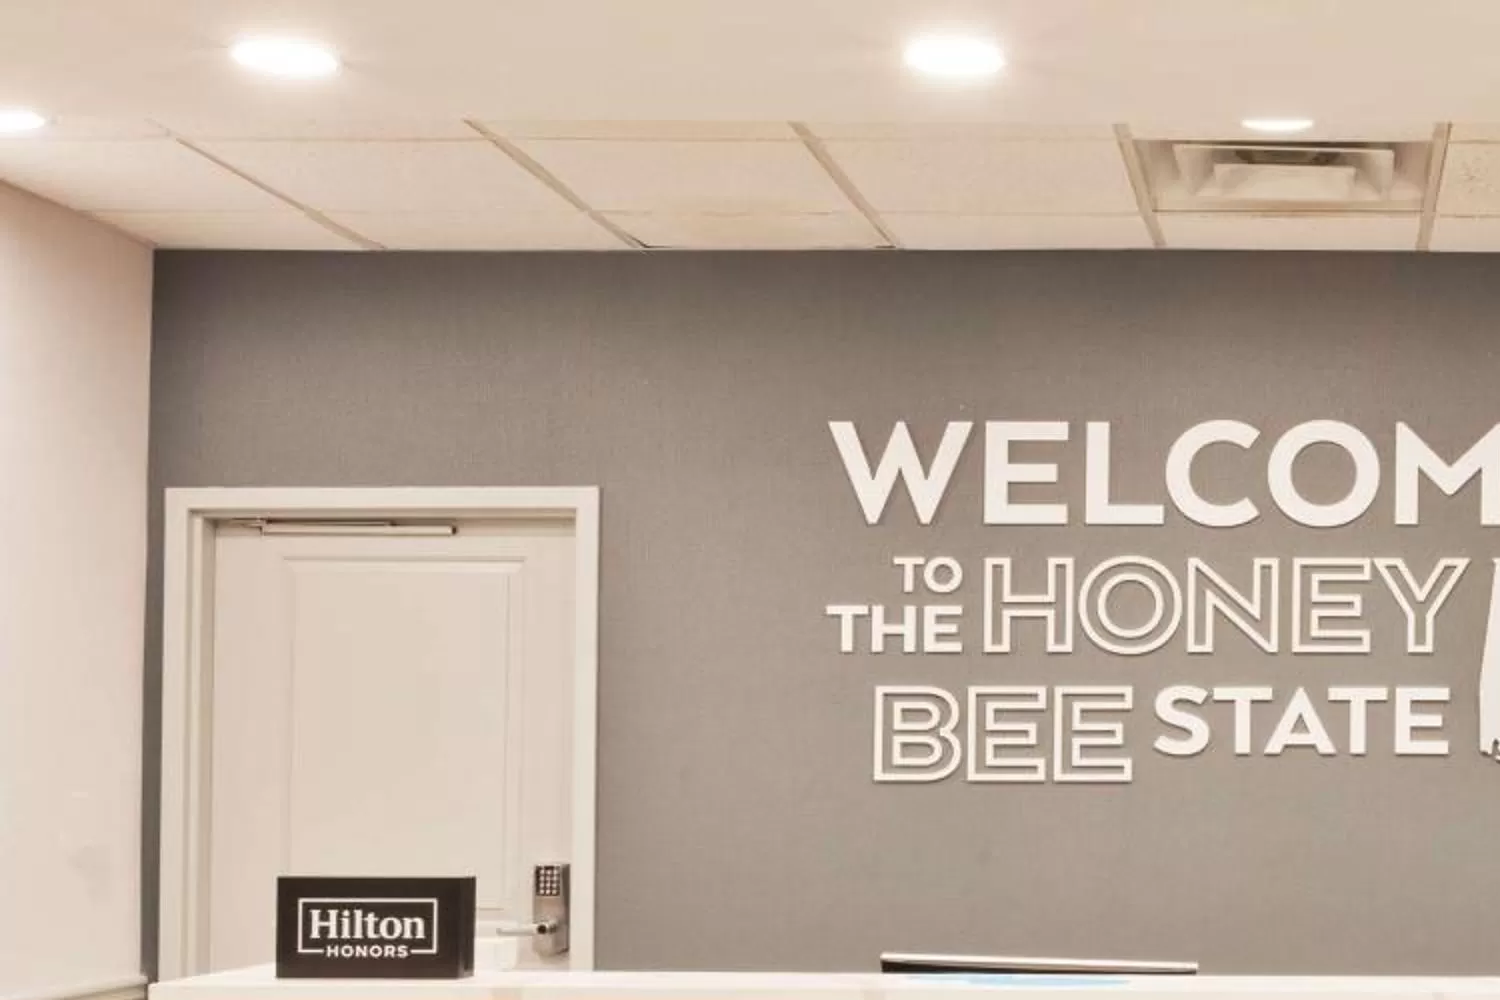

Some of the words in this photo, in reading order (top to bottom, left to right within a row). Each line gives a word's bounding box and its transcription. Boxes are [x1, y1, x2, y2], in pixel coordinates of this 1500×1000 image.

[893, 555, 964, 594] TO
[826, 604, 964, 653] THE
[982, 554, 1469, 656] HONEY
[872, 685, 1133, 782] BEE
[1152, 685, 1450, 756] STATE
[309, 909, 426, 940] Hilton
[325, 944, 409, 959] HONORS
